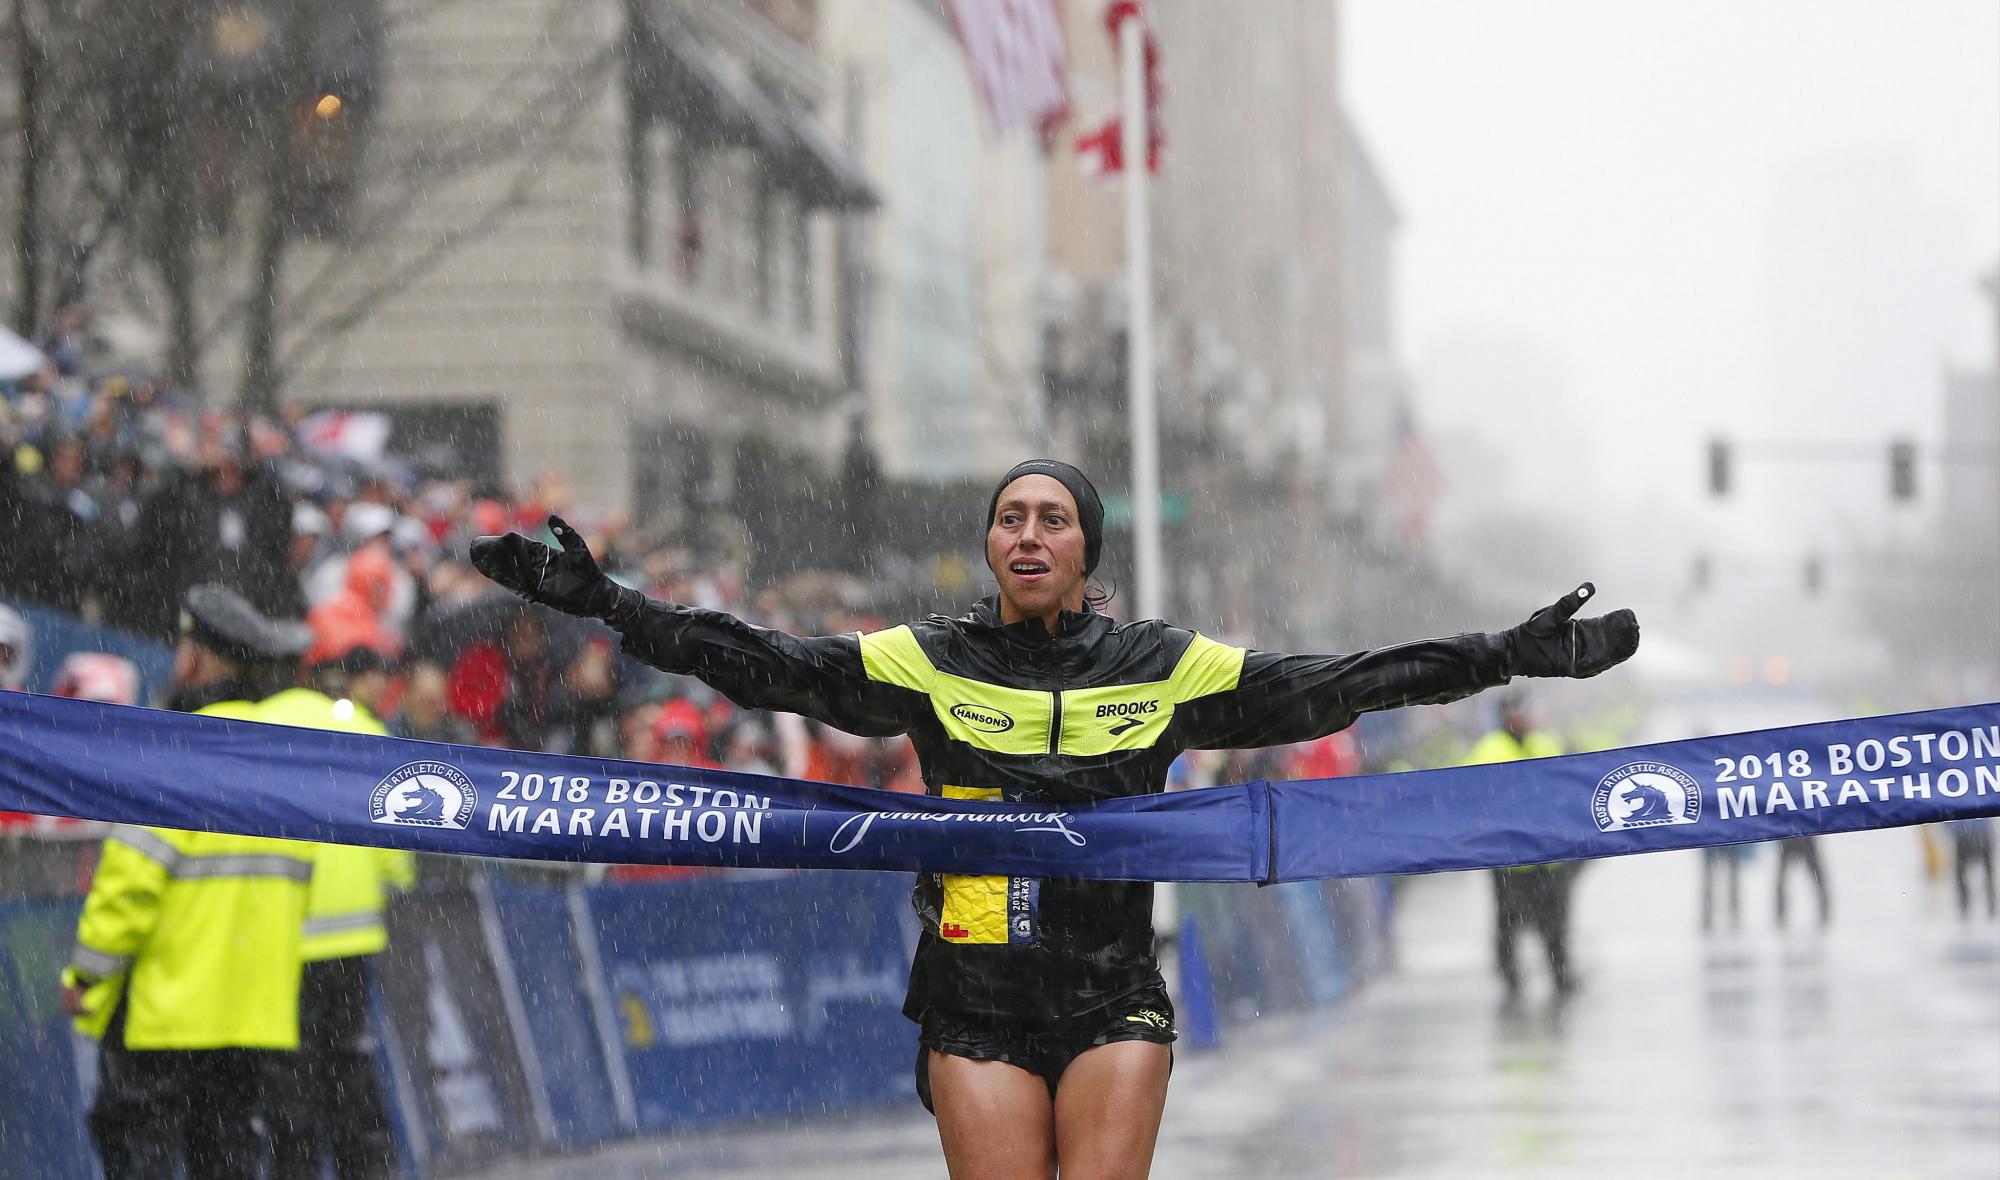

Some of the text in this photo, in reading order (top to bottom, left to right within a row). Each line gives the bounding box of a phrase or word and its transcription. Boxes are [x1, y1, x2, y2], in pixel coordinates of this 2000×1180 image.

[957, 708, 1009, 728] HANSONS
[1096, 700, 1158, 717] BROOKS
[1715, 726, 2000, 783] 2018 BOSTON
[373, 763, 475, 822] BOSTON ATHLETIC ASSOCIATION
[496, 771, 590, 803] 2018
[1595, 763, 1699, 825] BOSTON ATHLETIC ASSOCIATION
[1716, 765, 2000, 820] MARATHON
[1012, 890, 1021, 910] 2018
